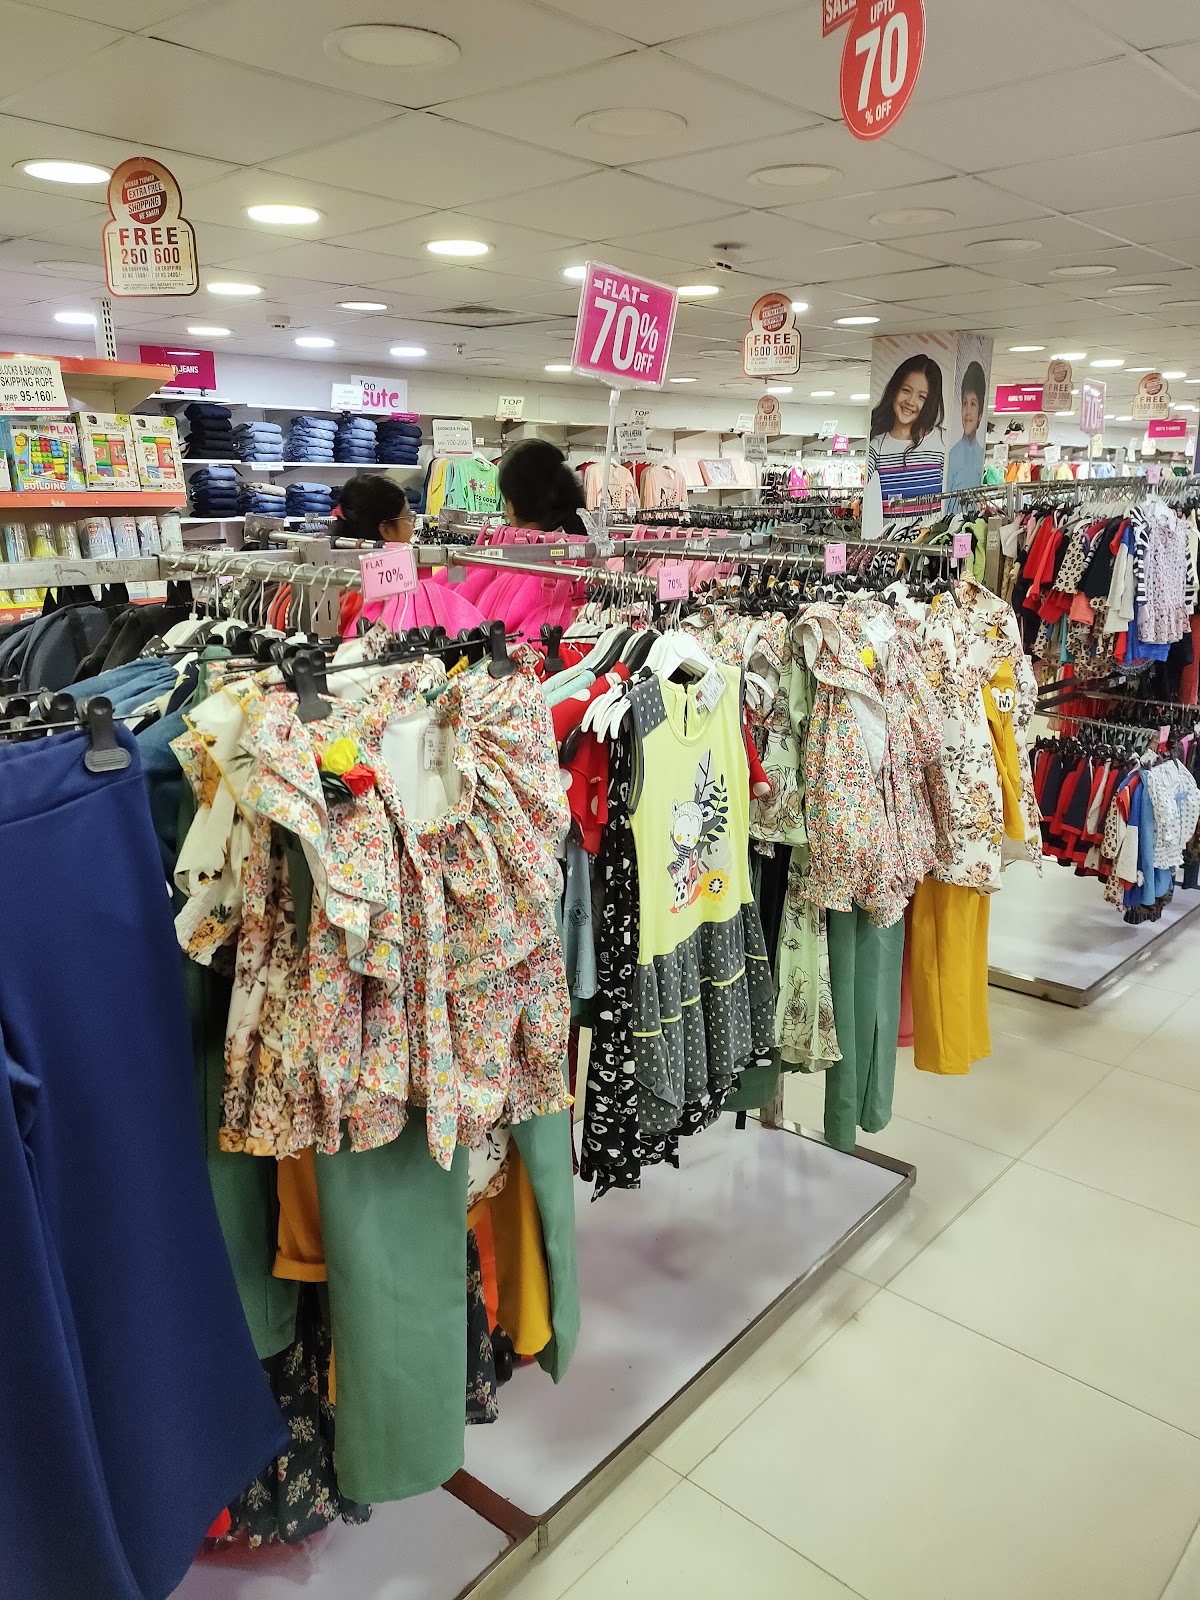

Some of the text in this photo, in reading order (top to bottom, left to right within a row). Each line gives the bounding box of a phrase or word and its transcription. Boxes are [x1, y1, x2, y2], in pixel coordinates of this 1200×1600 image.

[855, 12, 908, 112] 70
[875, 99, 892, 121] OFF
[128, 181, 162, 199] EXTRA FREE
[128, 196, 160, 213] SHOPPING
[118, 227, 179, 246] FREE
[121, 248, 148, 265] 250
[153, 247, 180, 264] 600
[603, 278, 640, 304] FLAT
[590, 297, 659, 371] 70%
[754, 333, 791, 345] FREE
[750, 346, 771, 357] 1500
[773, 345, 796, 356] 3000
[179, 365, 199, 374] JEANS
[633, 351, 655, 374] OFF
[24, 366, 52, 377] BADMINTON
[0, 376, 54, 388] SKIPPING ROPE
[1048, 384, 1069, 392] FREE
[20, 390, 57, 402] 95-160/-
[363, 388, 400, 408] cute
[23, 482, 67, 491] BUILDING
[365, 559, 383, 570] FLAT
[378, 567, 404, 585] 70%
[668, 578, 682, 590] 70%
[998, 695, 1011, 708] M
